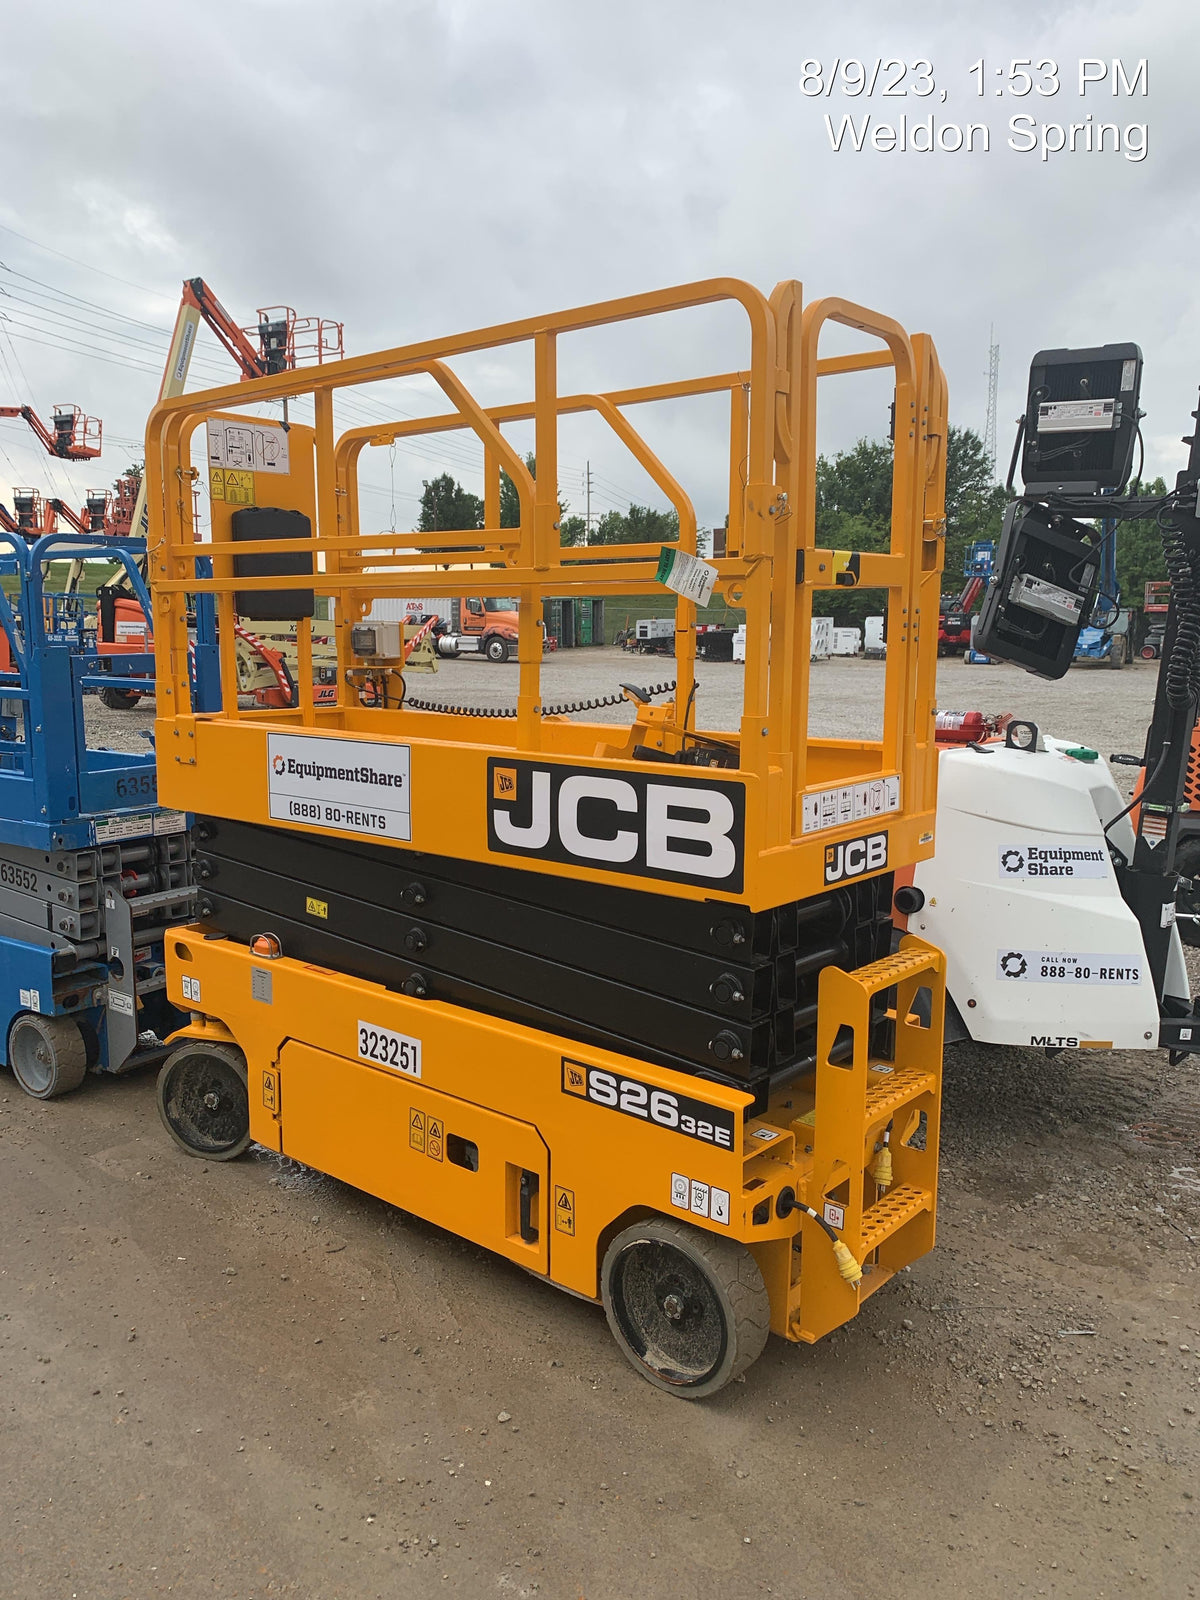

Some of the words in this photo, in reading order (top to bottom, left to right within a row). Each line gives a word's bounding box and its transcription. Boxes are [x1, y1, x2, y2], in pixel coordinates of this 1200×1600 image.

[318, 689, 335, 698] JLG
[287, 758, 403, 788] EquipmentShare
[498, 774, 514, 792] JCB
[289, 800, 321, 820] (888)
[325, 807, 386, 830] 80-RENTS
[493, 770, 736, 879] JCB
[825, 834, 887, 882] JCB
[1027, 847, 1105, 863] Equipment
[0, 863, 38, 893] 63552
[1027, 862, 1074, 876] Share
[1040, 965, 1139, 980] 888-80-RENTS
[1030, 1035, 1079, 1047] MLTS
[360, 1028, 417, 1073] 323251
[569, 1070, 583, 1085] JCB
